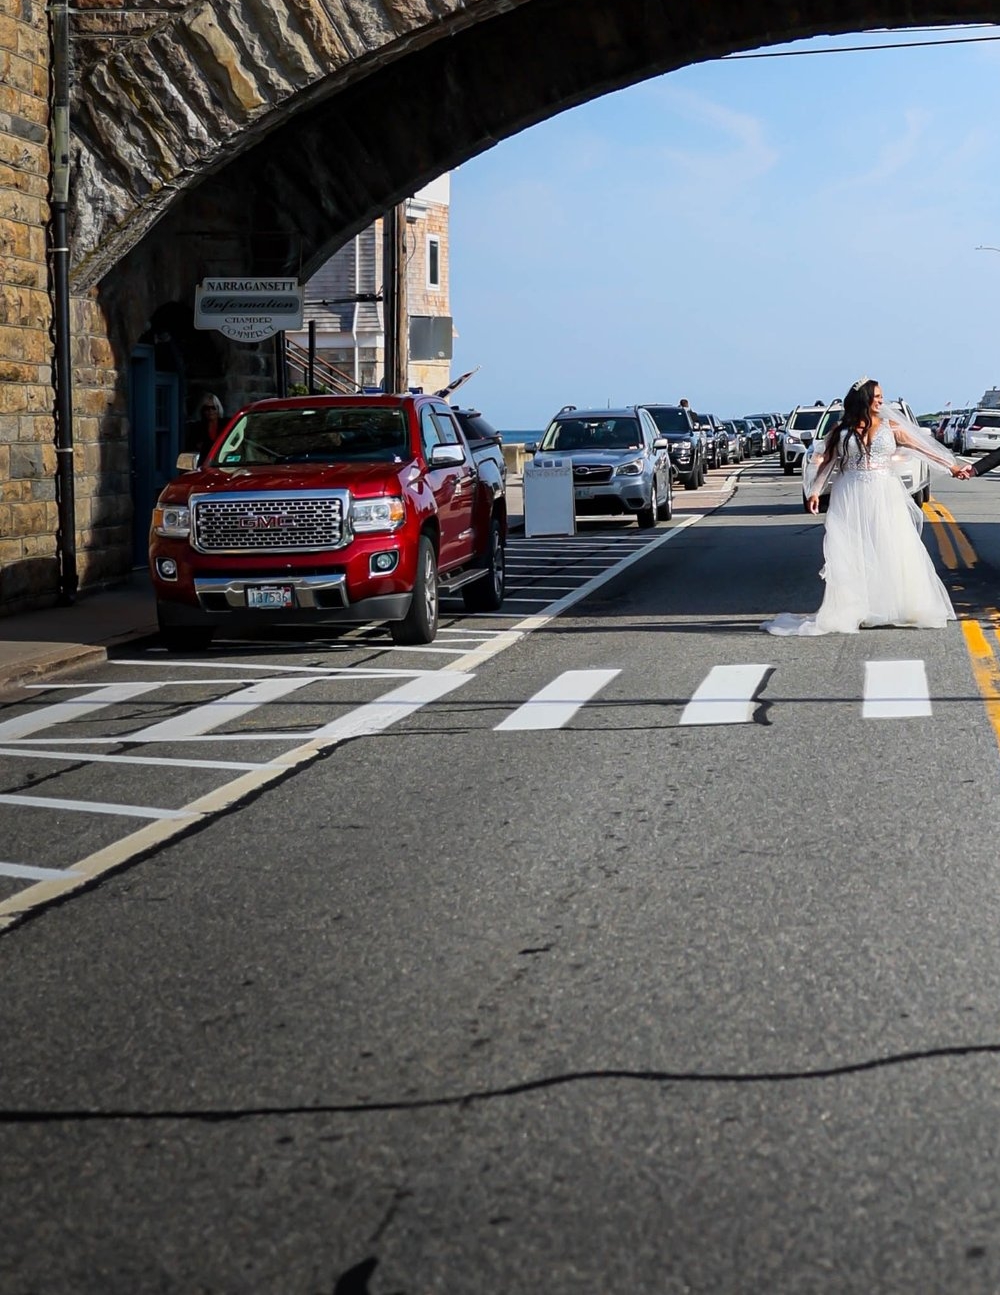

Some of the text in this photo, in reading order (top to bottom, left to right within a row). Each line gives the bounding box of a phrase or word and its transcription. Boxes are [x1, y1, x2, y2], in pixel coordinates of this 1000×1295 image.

[207, 281, 295, 291] NARRAGANSETT
[202, 298, 293, 312] Information
[224, 316, 272, 324] CHAMBER
[239, 515, 297, 529] GMC
